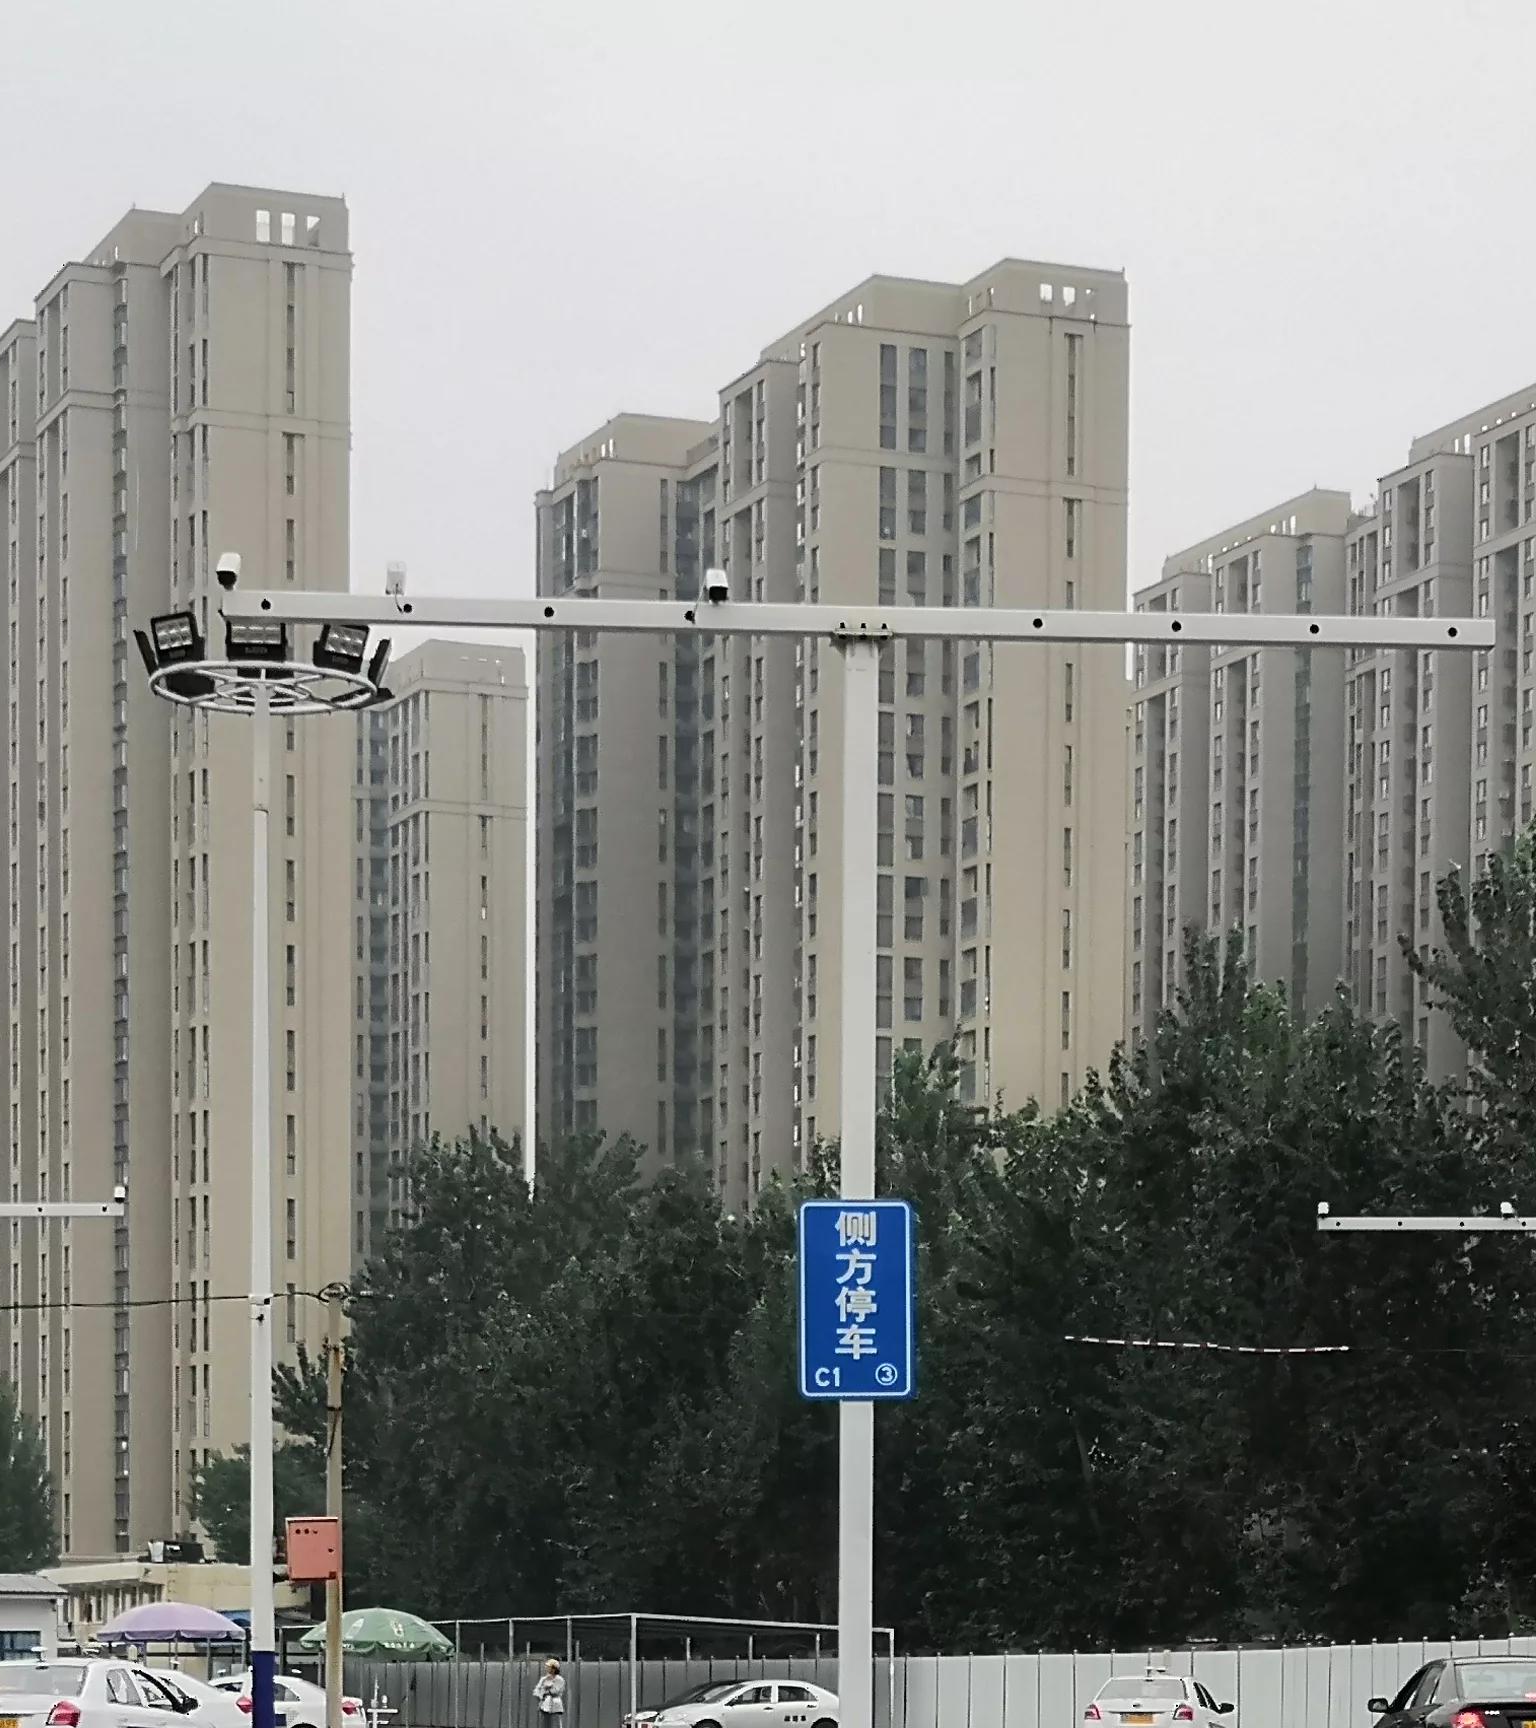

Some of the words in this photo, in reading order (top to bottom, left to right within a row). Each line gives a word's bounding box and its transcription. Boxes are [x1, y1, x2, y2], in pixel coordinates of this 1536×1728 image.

[835, 1211, 877, 1360] 侧方停车
[815, 1367, 841, 1387] C1
